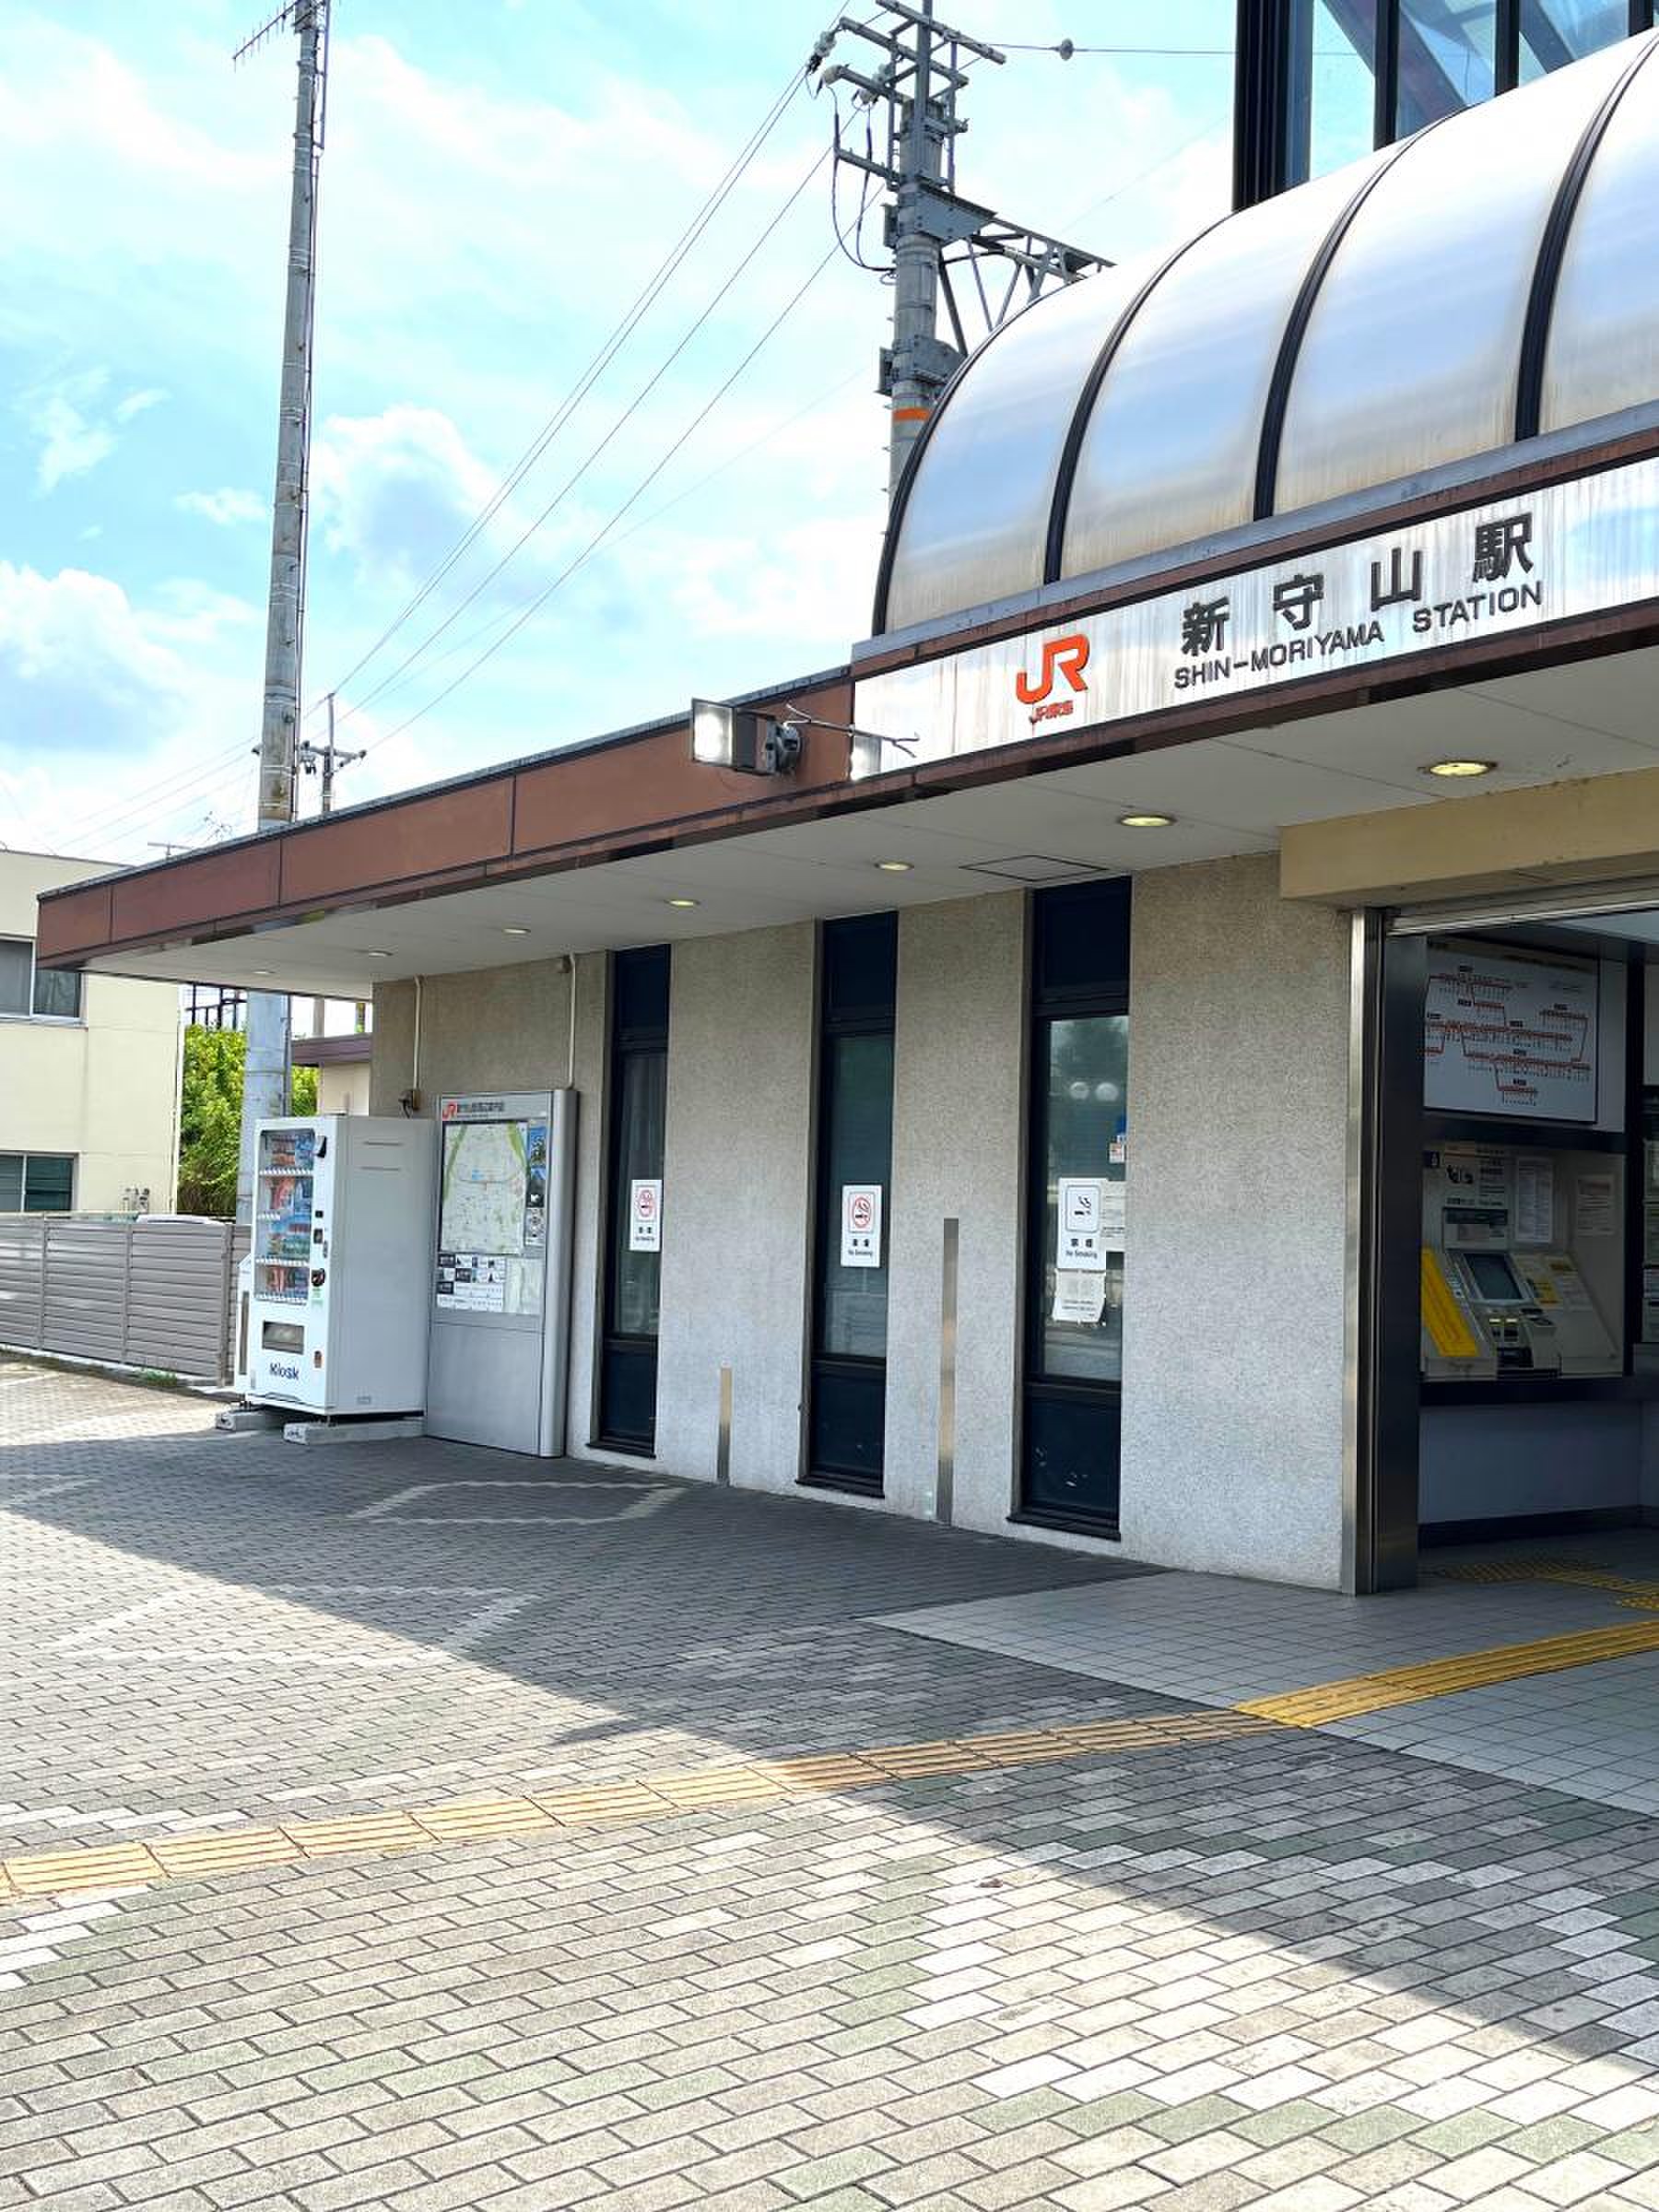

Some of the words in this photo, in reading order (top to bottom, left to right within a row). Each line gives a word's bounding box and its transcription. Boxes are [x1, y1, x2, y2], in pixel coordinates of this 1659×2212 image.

[1181, 512, 1534, 657] 新守山駅
[1016, 634, 1089, 704] JR
[1174, 620, 1385, 689] SHIN-MORIYAMA
[1412, 581, 1542, 634] STATION
[269, 1362, 300, 1381] Kiosk
